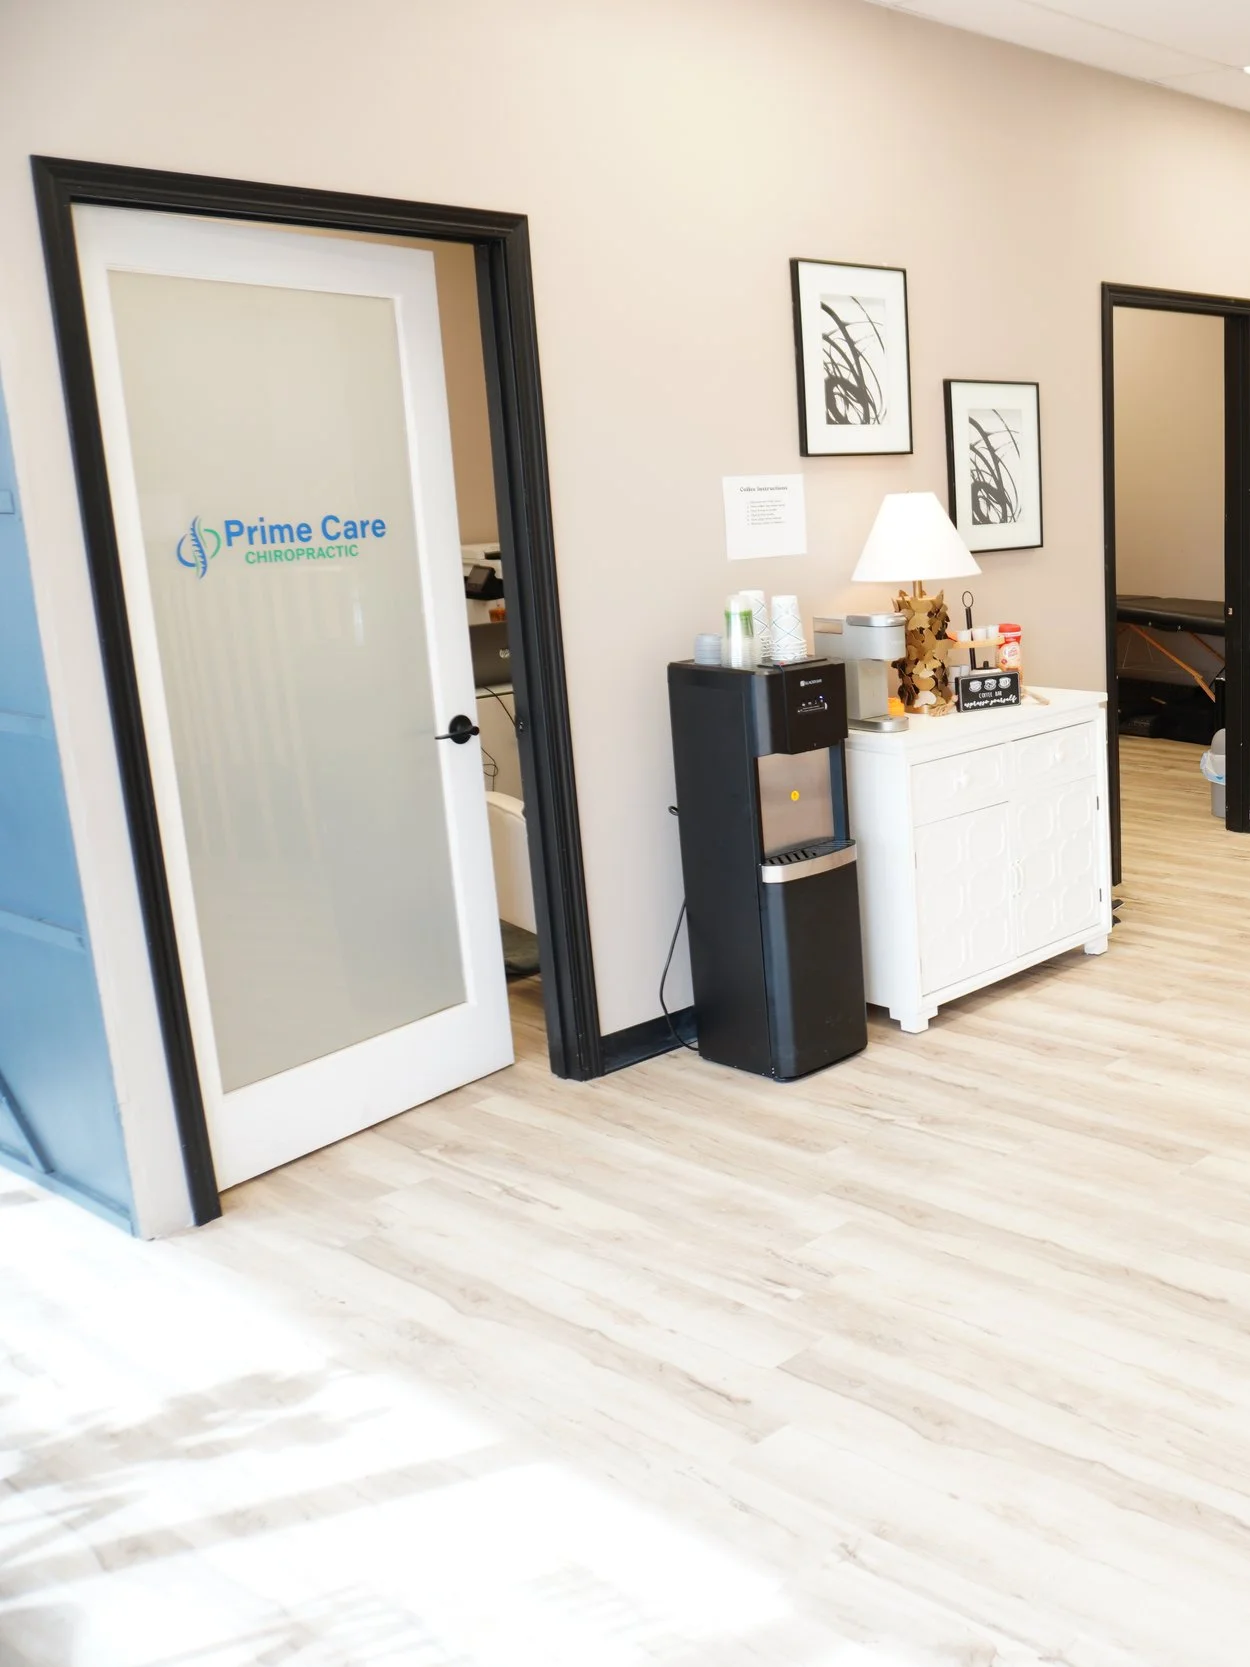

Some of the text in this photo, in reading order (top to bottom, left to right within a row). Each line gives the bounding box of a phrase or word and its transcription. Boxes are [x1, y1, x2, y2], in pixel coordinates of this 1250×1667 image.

[224, 514, 387, 547] Prime Care
[245, 544, 359, 564] CHIROPRACTIC
